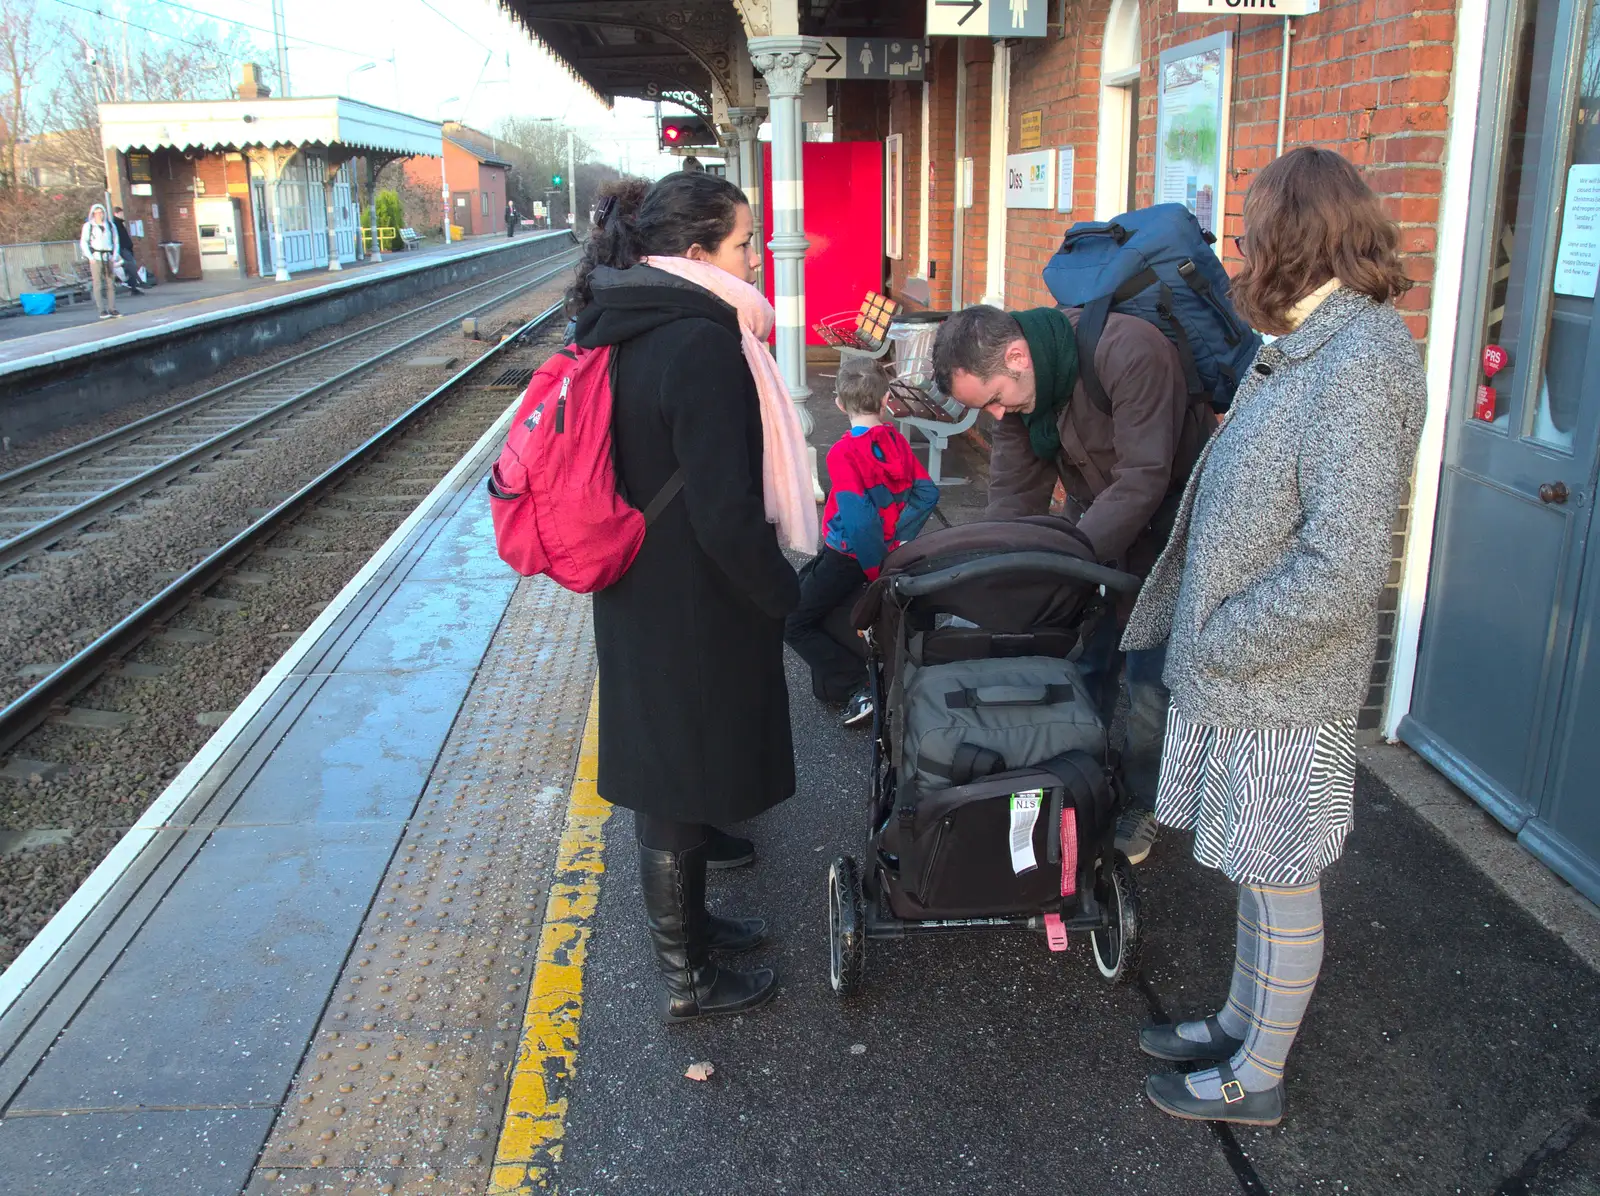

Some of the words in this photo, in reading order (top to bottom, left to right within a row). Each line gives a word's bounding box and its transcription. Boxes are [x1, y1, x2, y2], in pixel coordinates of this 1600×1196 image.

[1009, 168, 1023, 189] Diss
[1486, 349, 1501, 363] PRS
[1016, 800, 1036, 809] STN
